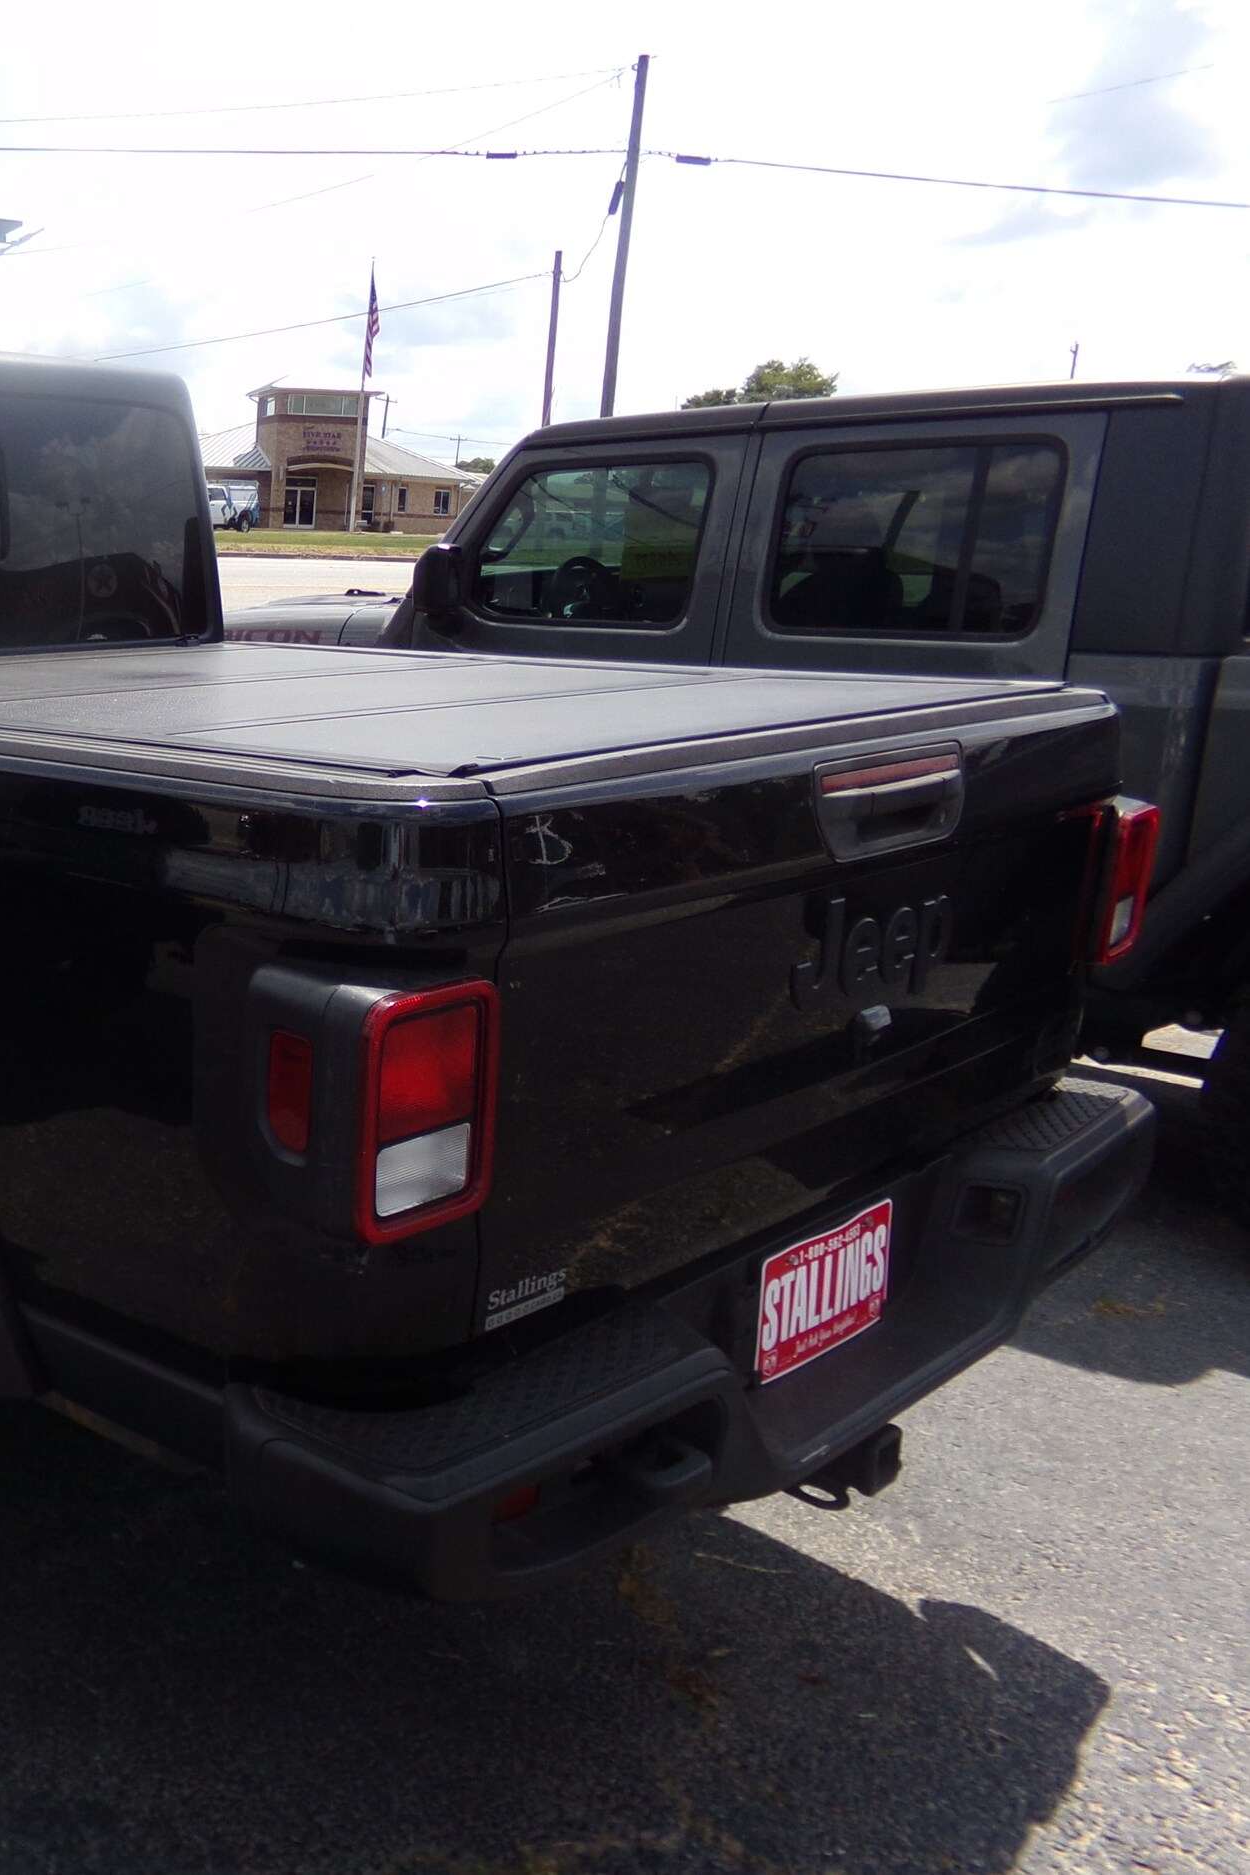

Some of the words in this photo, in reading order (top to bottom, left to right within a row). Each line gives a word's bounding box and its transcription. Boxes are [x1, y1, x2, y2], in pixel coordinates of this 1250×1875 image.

[790, 894, 955, 1011] Jeep
[487, 1267, 568, 1311] Stallings
[761, 1224, 888, 1352] STALLINGS
